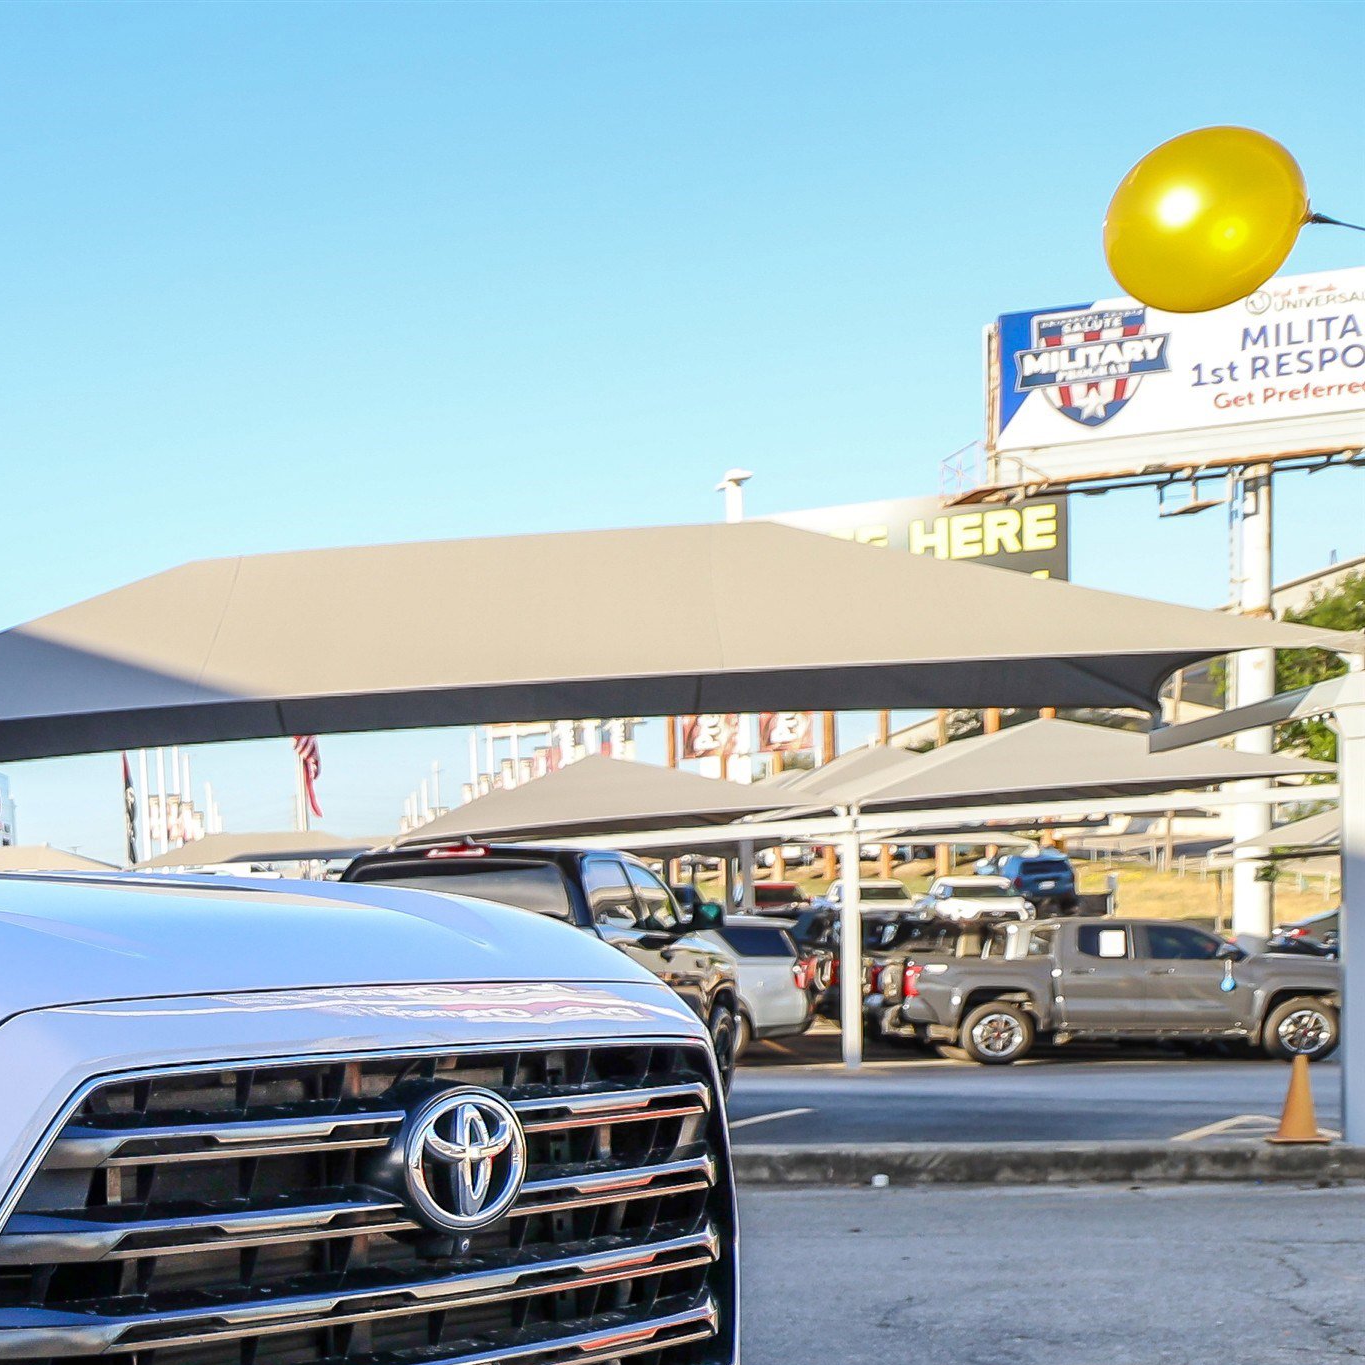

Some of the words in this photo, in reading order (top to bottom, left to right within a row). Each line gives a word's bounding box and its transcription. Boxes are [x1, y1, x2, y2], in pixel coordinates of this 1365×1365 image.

[1240, 313, 1363, 352] MILITA
[1022, 336, 1165, 377] MILITARY
[1191, 361, 1239, 387] 1st
[1250, 343, 1365, 381] RESPO
[1213, 391, 1254, 409] Get
[908, 503, 1058, 561] HERE
